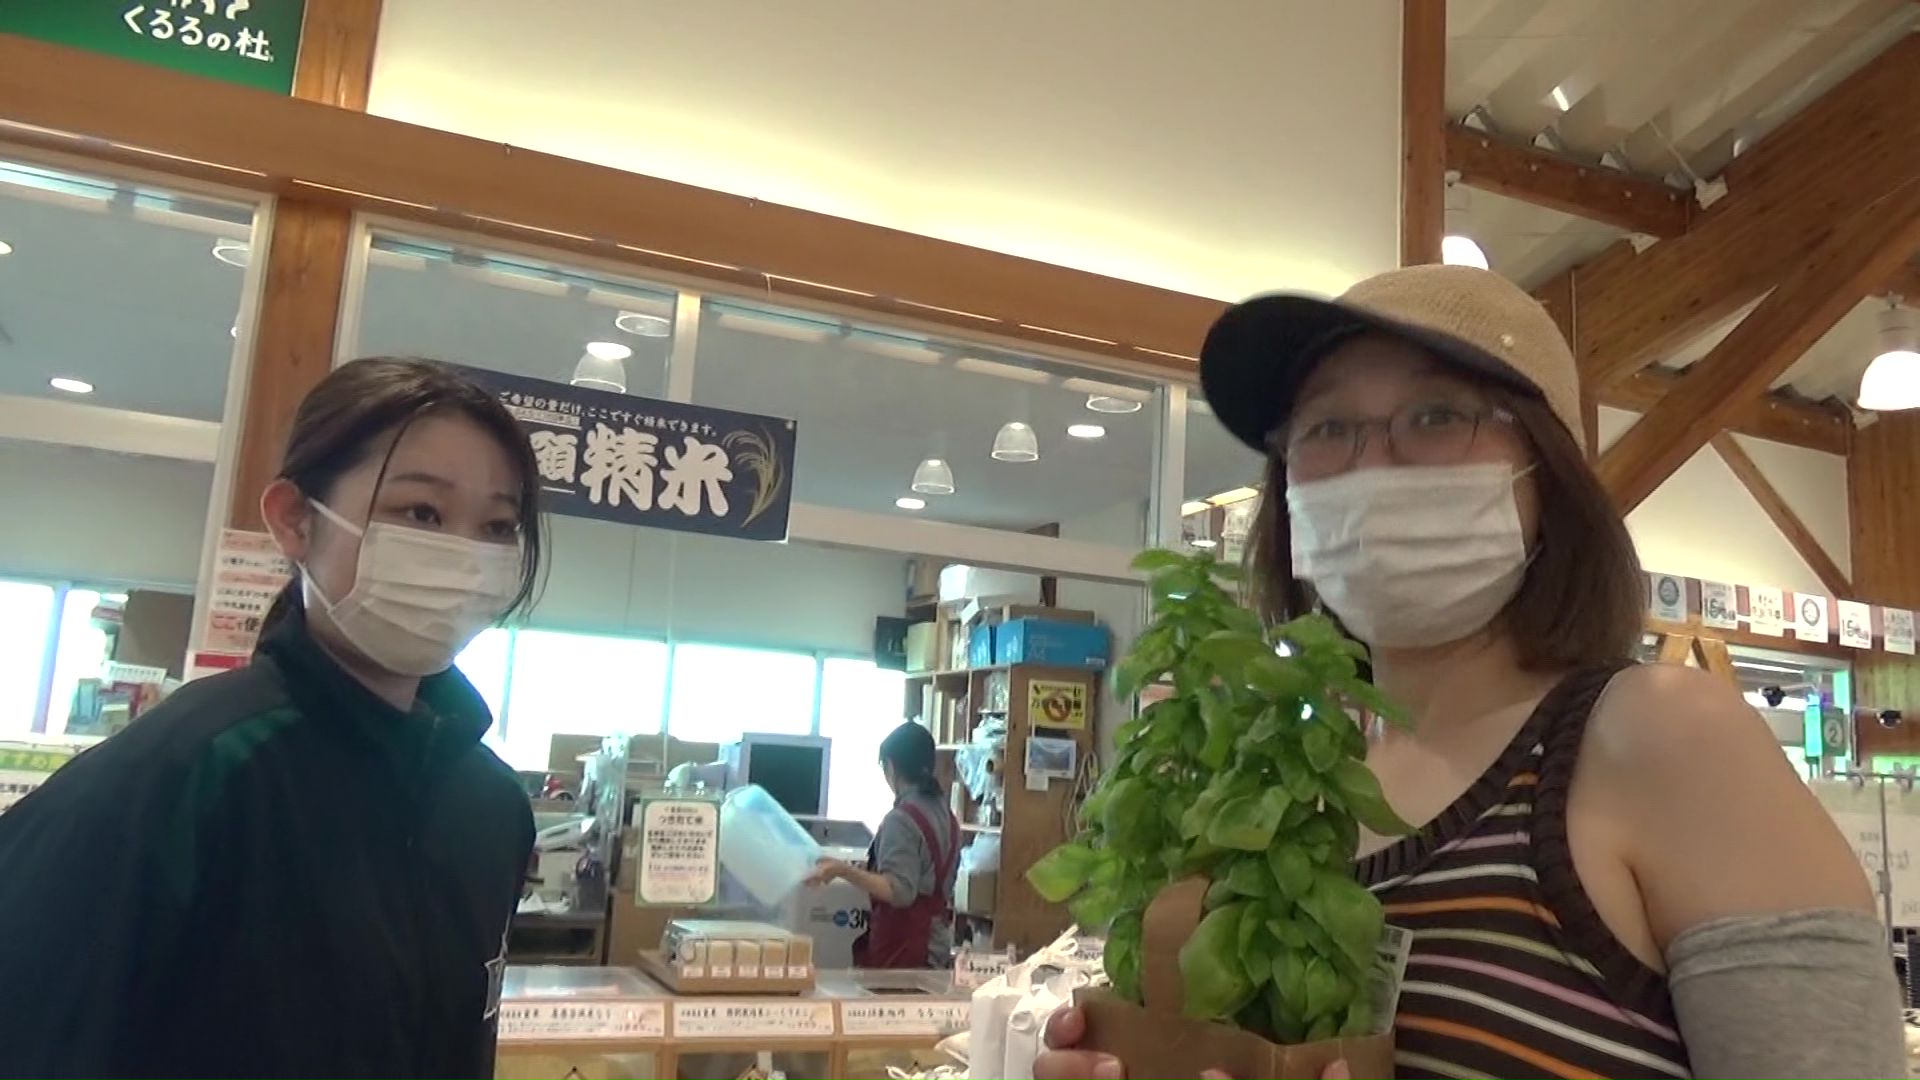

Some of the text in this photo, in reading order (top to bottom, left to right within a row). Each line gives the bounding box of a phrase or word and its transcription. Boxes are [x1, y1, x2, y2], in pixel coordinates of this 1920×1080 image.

[123, 5, 270, 62] くるるの杜
[1827, 726, 1839, 742] 2
